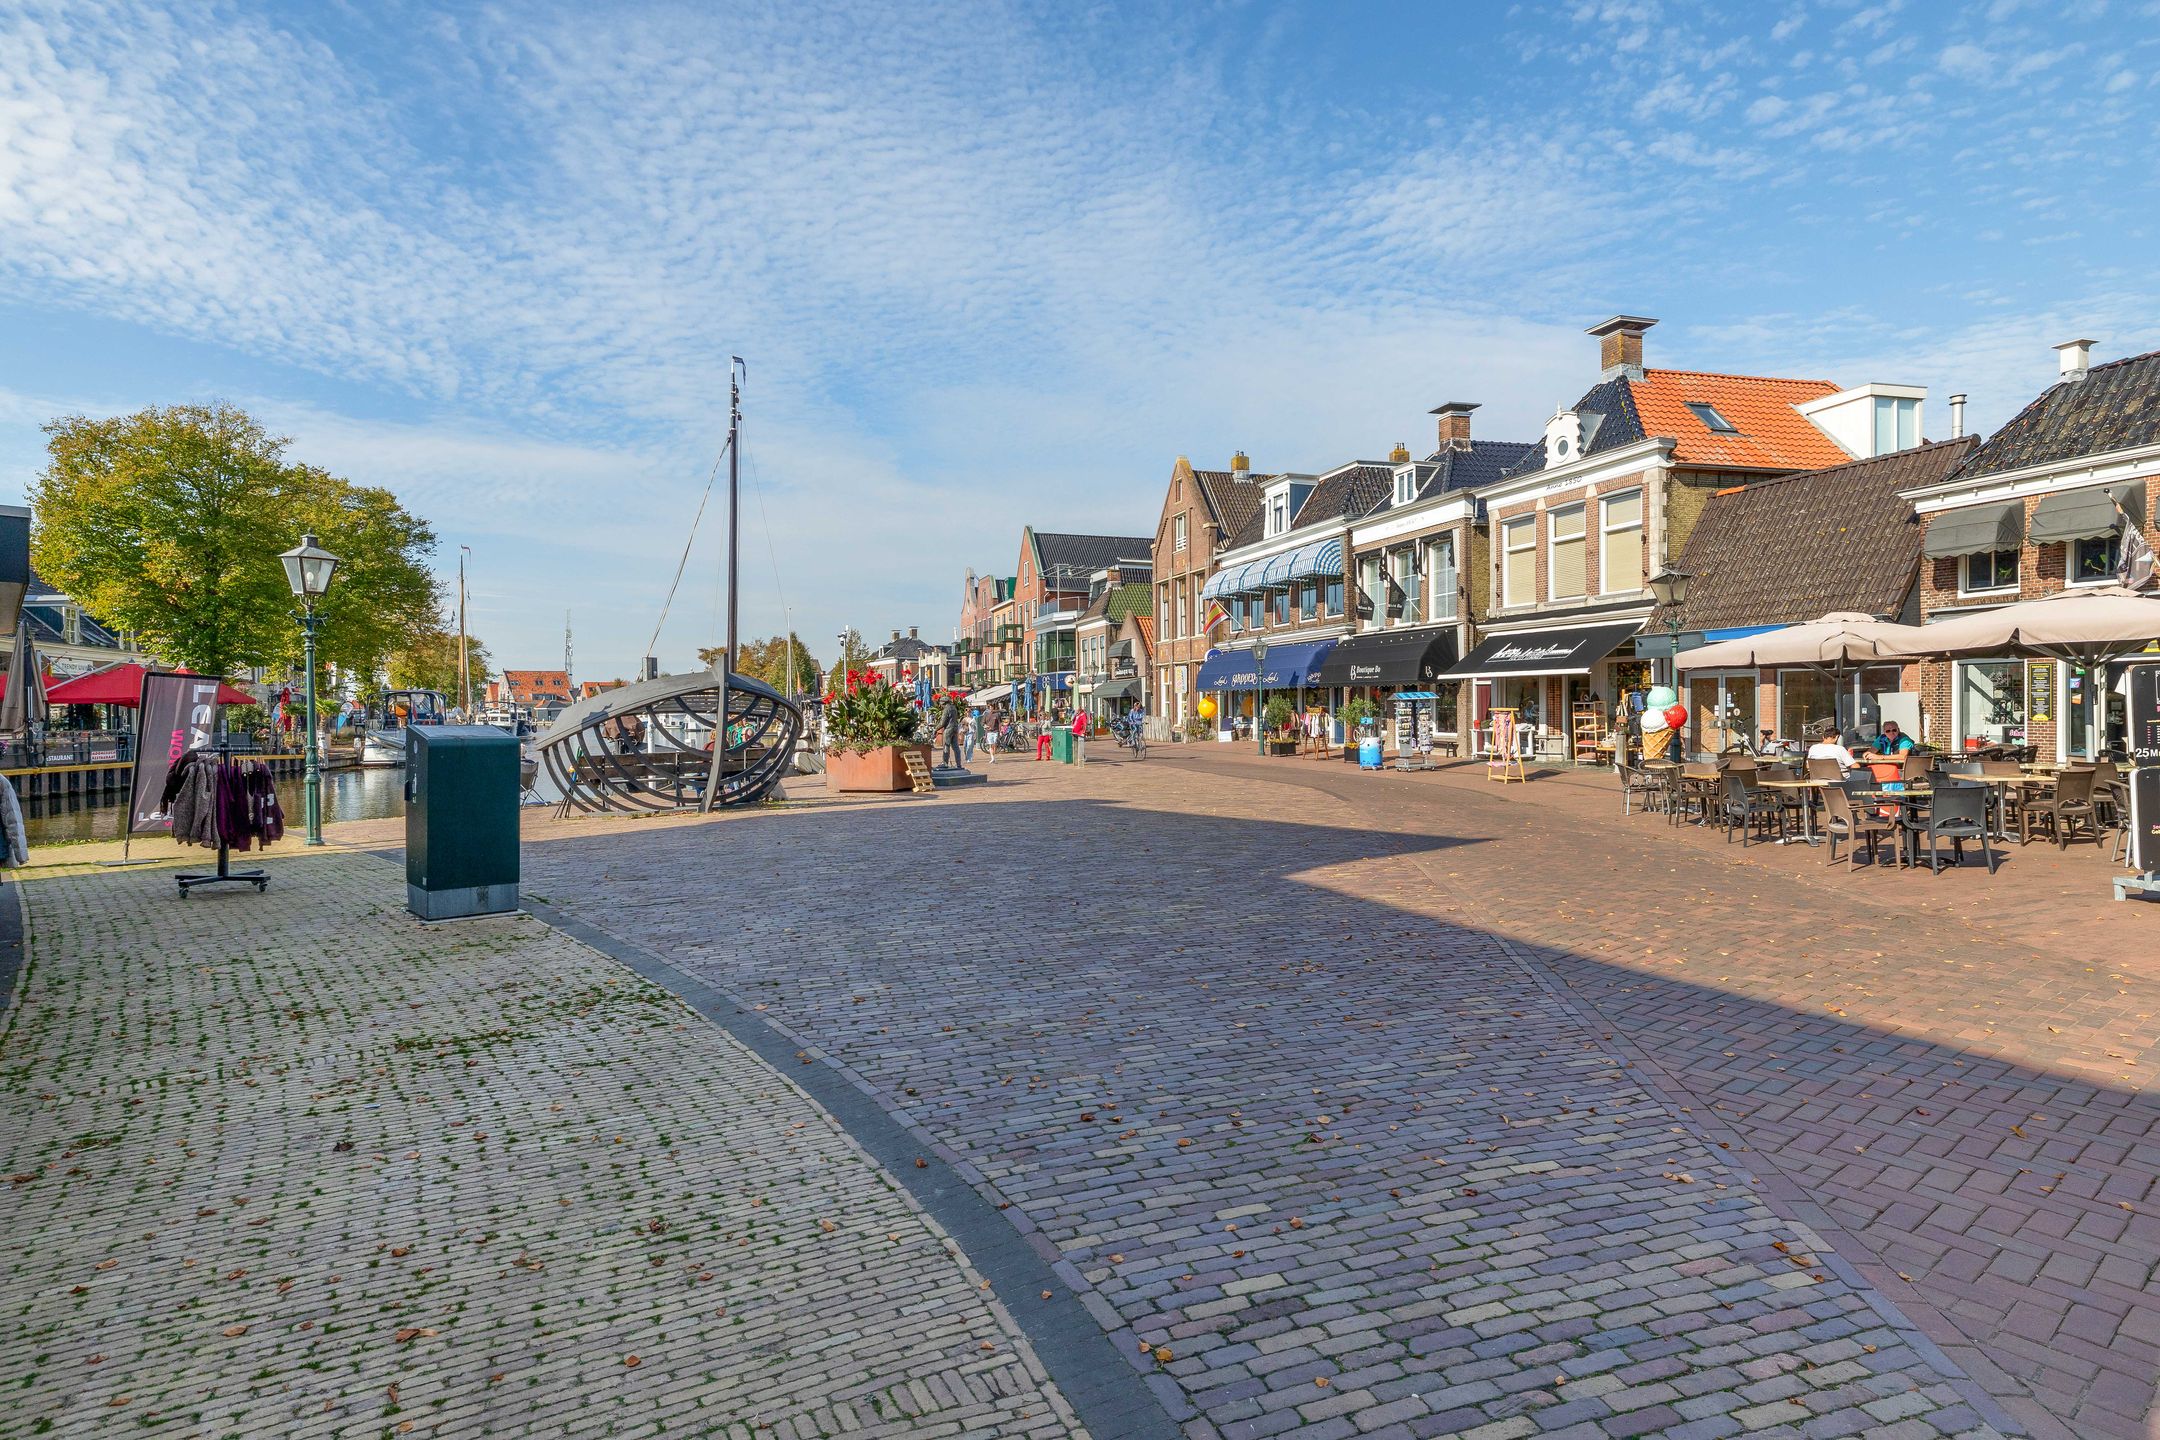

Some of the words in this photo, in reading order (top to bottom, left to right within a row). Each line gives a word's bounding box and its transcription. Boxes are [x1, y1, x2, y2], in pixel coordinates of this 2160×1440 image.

[1356, 665, 1375, 674] Boutique
[1375, 665, 1381, 673] Bo
[2135, 748, 2149, 758] 25
